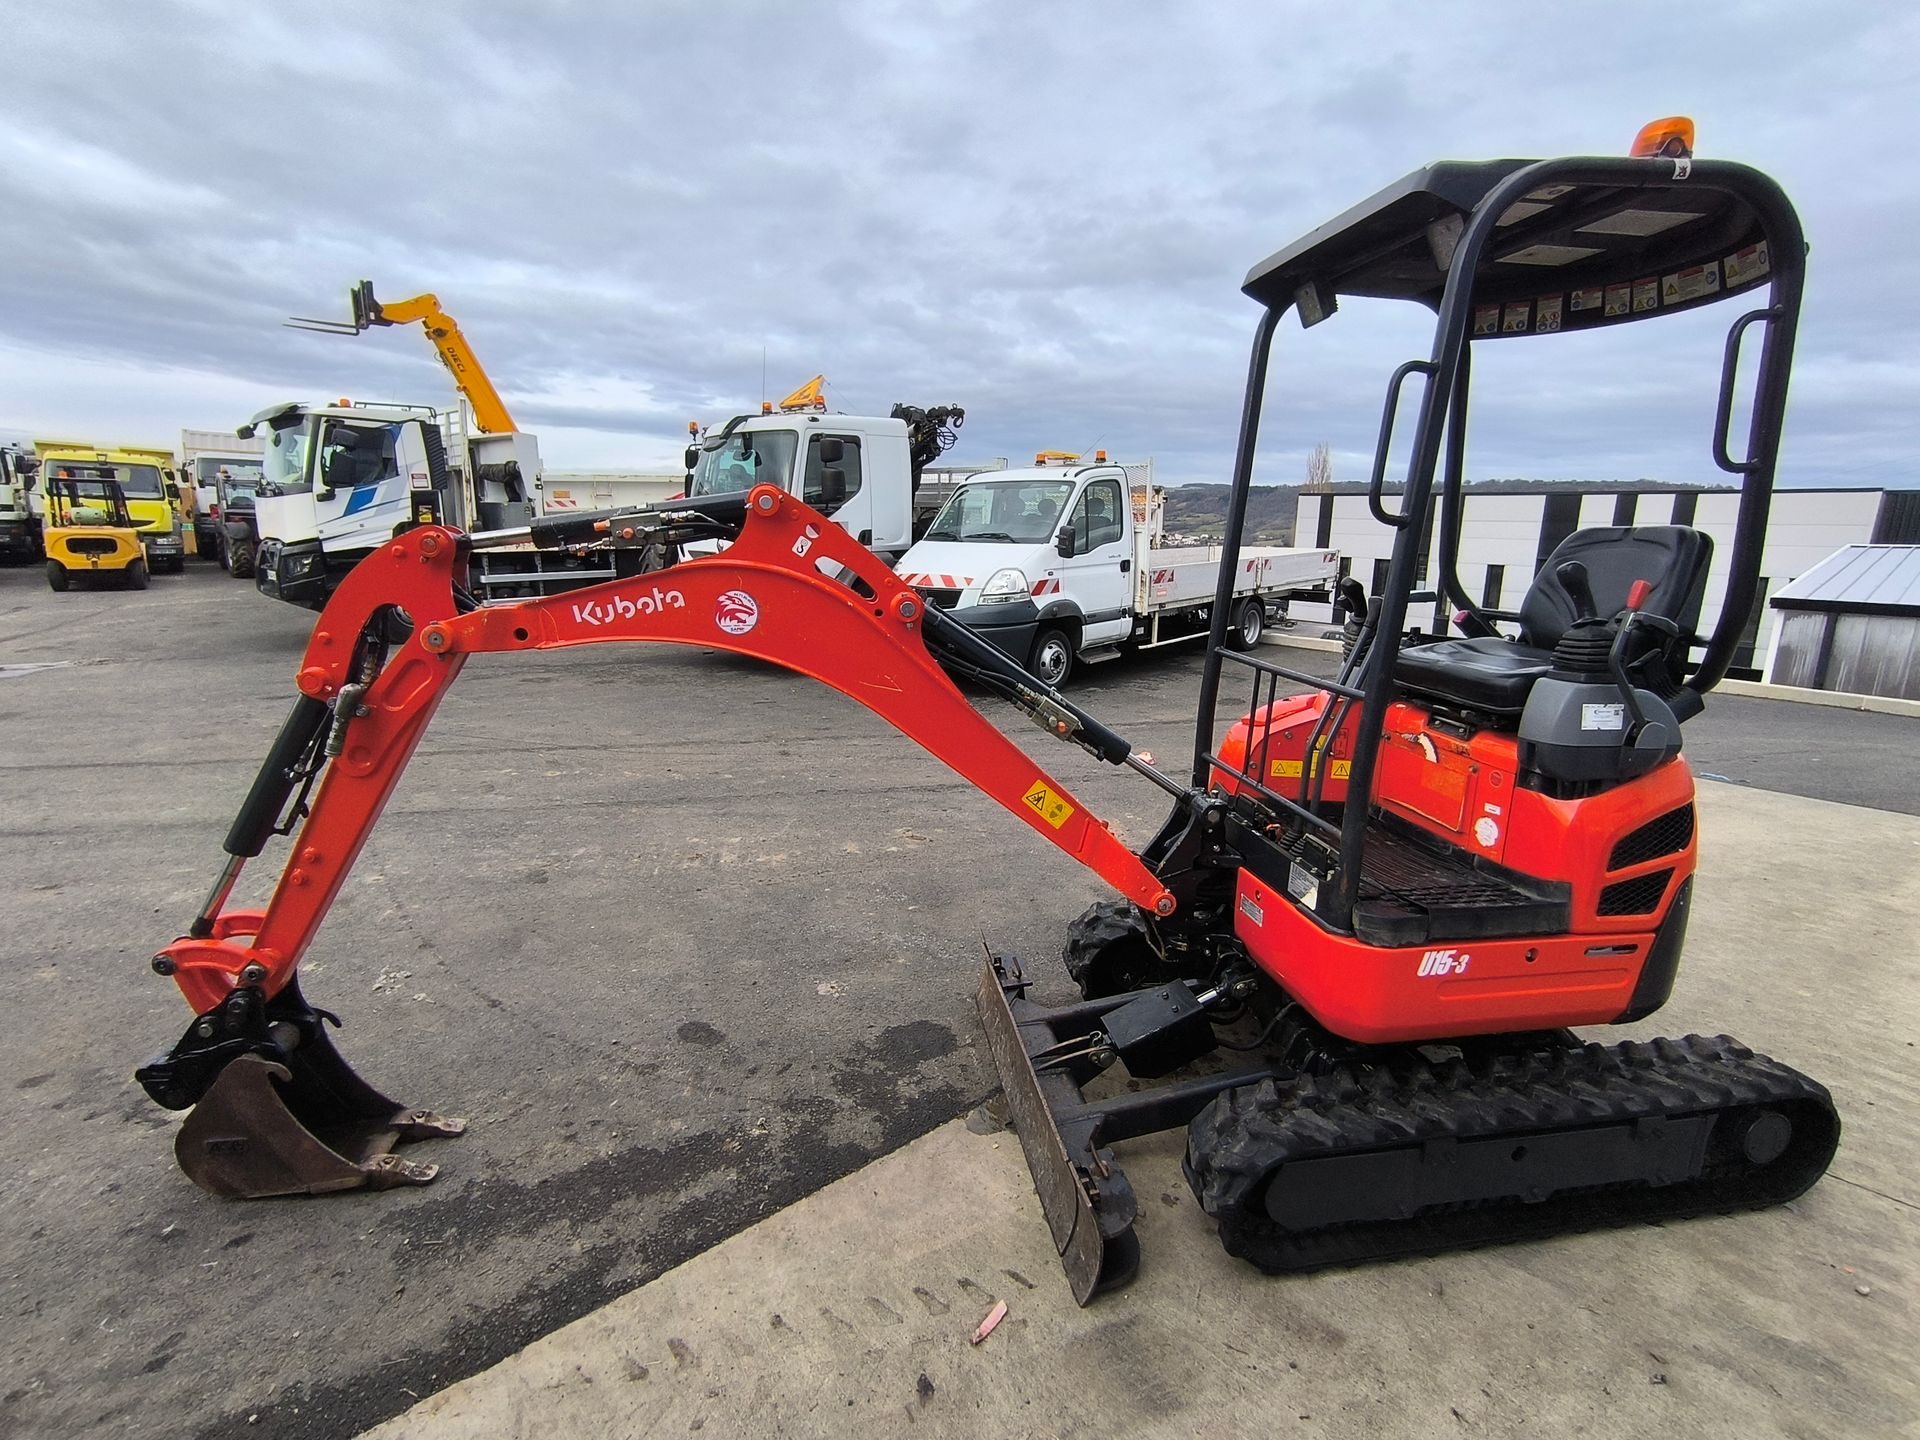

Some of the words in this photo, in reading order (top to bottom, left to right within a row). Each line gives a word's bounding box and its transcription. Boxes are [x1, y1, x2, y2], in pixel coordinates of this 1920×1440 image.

[447, 347, 465, 372] DIECI
[572, 587, 686, 626] Kubota
[1417, 949, 1470, 977] U15-3
